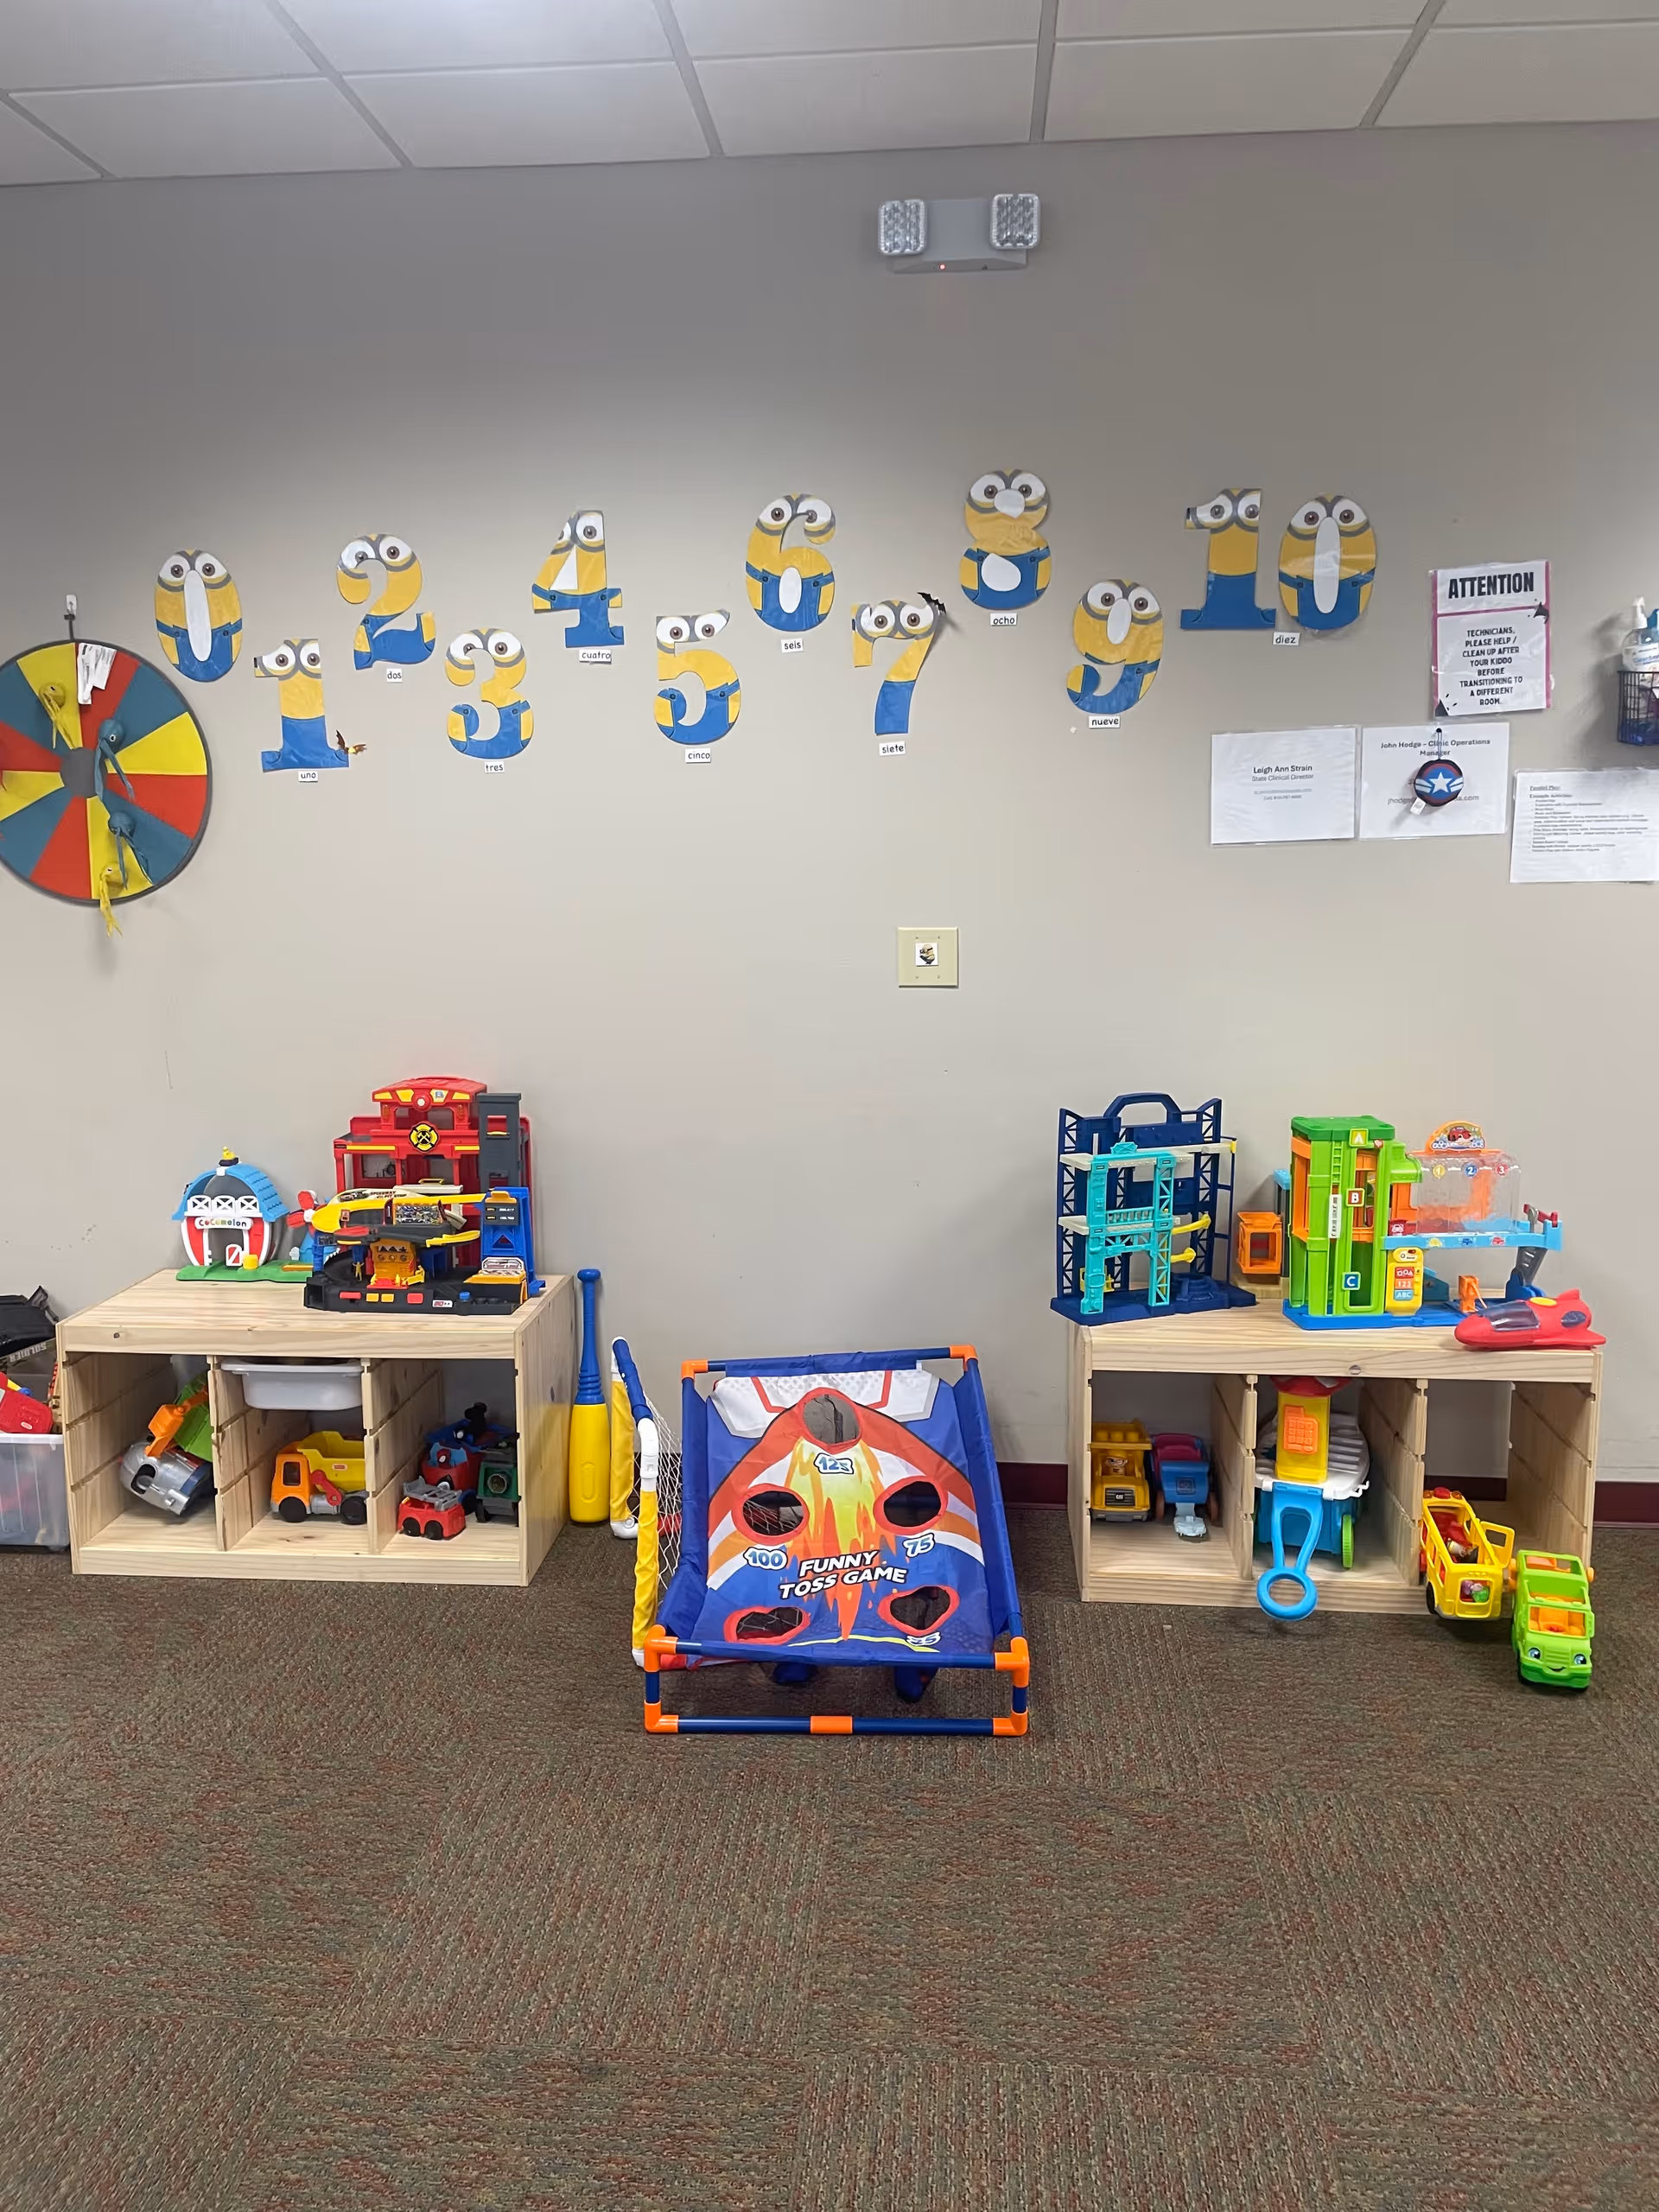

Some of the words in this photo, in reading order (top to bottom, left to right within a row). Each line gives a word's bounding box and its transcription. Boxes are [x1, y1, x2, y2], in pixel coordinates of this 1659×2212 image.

[959, 469, 1052, 610] 8
[746, 493, 836, 632] 6
[532, 510, 624, 647] 4
[1448, 572, 1534, 599] ATTENTION
[337, 533, 435, 670] 2
[993, 616, 1014, 625] ocho
[784, 640, 801, 650] seis
[1275, 635, 1296, 644] diez
[1465, 639, 1491, 647] PLEASE
[1066, 580, 1162, 714] 9
[1497, 646, 1519, 655] AFTER
[582, 651, 611, 659] cuatro
[852, 601, 938, 735] 7
[1478, 667, 1504, 676] BEFORE
[387, 671, 402, 679] dos
[654, 608, 741, 745] 5
[1459, 677, 1512, 688] TRANSITIONING
[445, 628, 534, 759] 3
[1477, 687, 1513, 696] DIFFERENT
[254, 639, 349, 771] 1
[1091, 717, 1119, 726] nueve
[881, 743, 905, 753] siete
[688, 751, 710, 760] cinco
[486, 763, 504, 772] tres
[1354, 1133, 1363, 1143] A
[1351, 1192, 1359, 1204] B
[1346, 1276, 1356, 1287] C
[10, 1342, 47, 1363] SOLDIER
[816, 1455, 852, 1473] 125
[905, 1536, 932, 1555] 75
[746, 1548, 785, 1567] 100
[798, 1550, 880, 1578] FUNNY
[779, 1573, 837, 1599] TOSS
[841, 1566, 907, 1585] GAME
